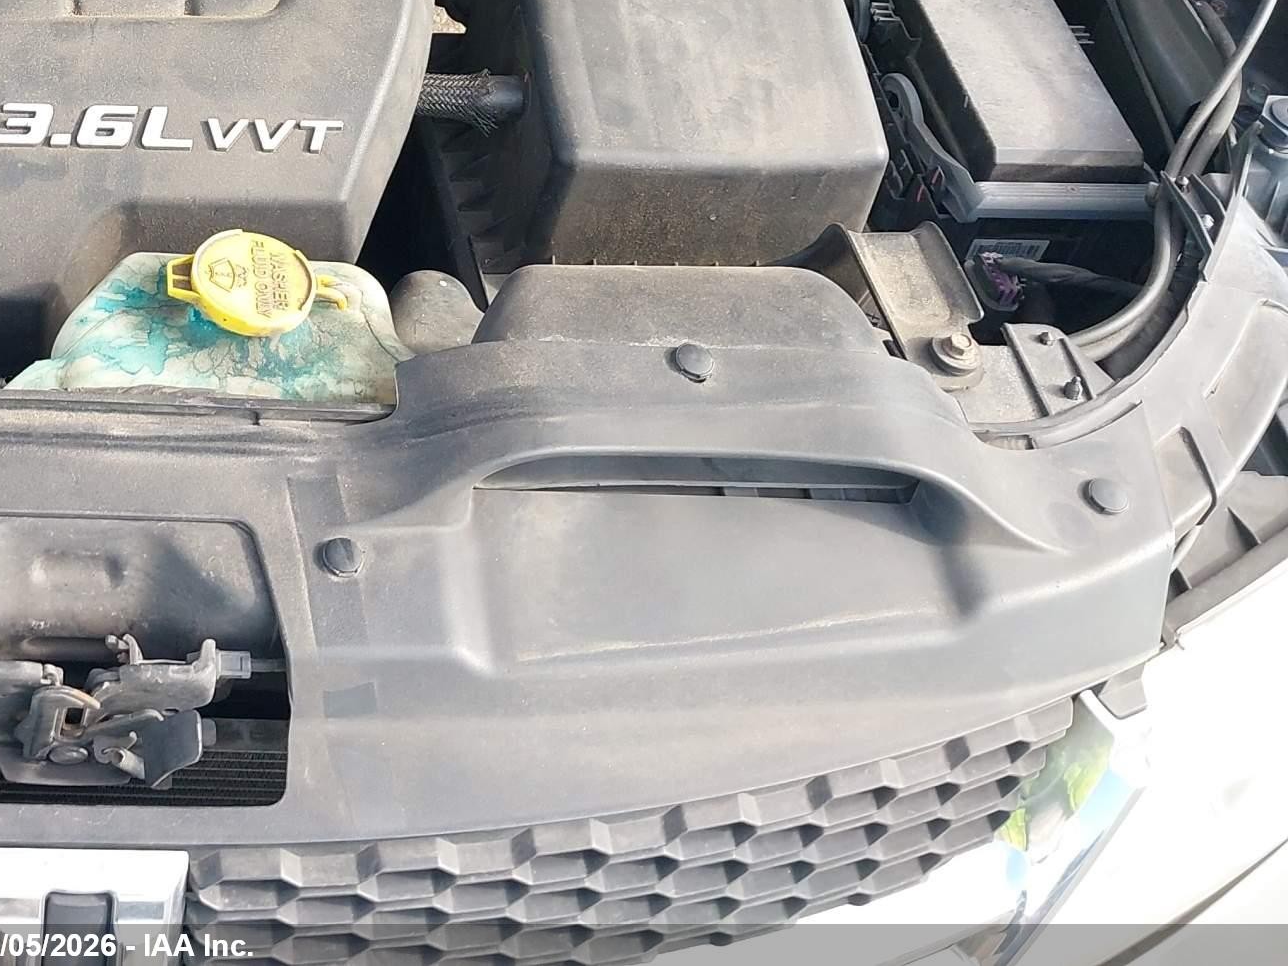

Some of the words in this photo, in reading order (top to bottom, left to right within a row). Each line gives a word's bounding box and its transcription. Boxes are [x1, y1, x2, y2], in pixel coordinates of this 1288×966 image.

[204, 117, 345, 154] VVT
[250, 240, 267, 278] FLUID
[255, 281, 272, 318] ONLY
[270, 252, 289, 310] WASHER
